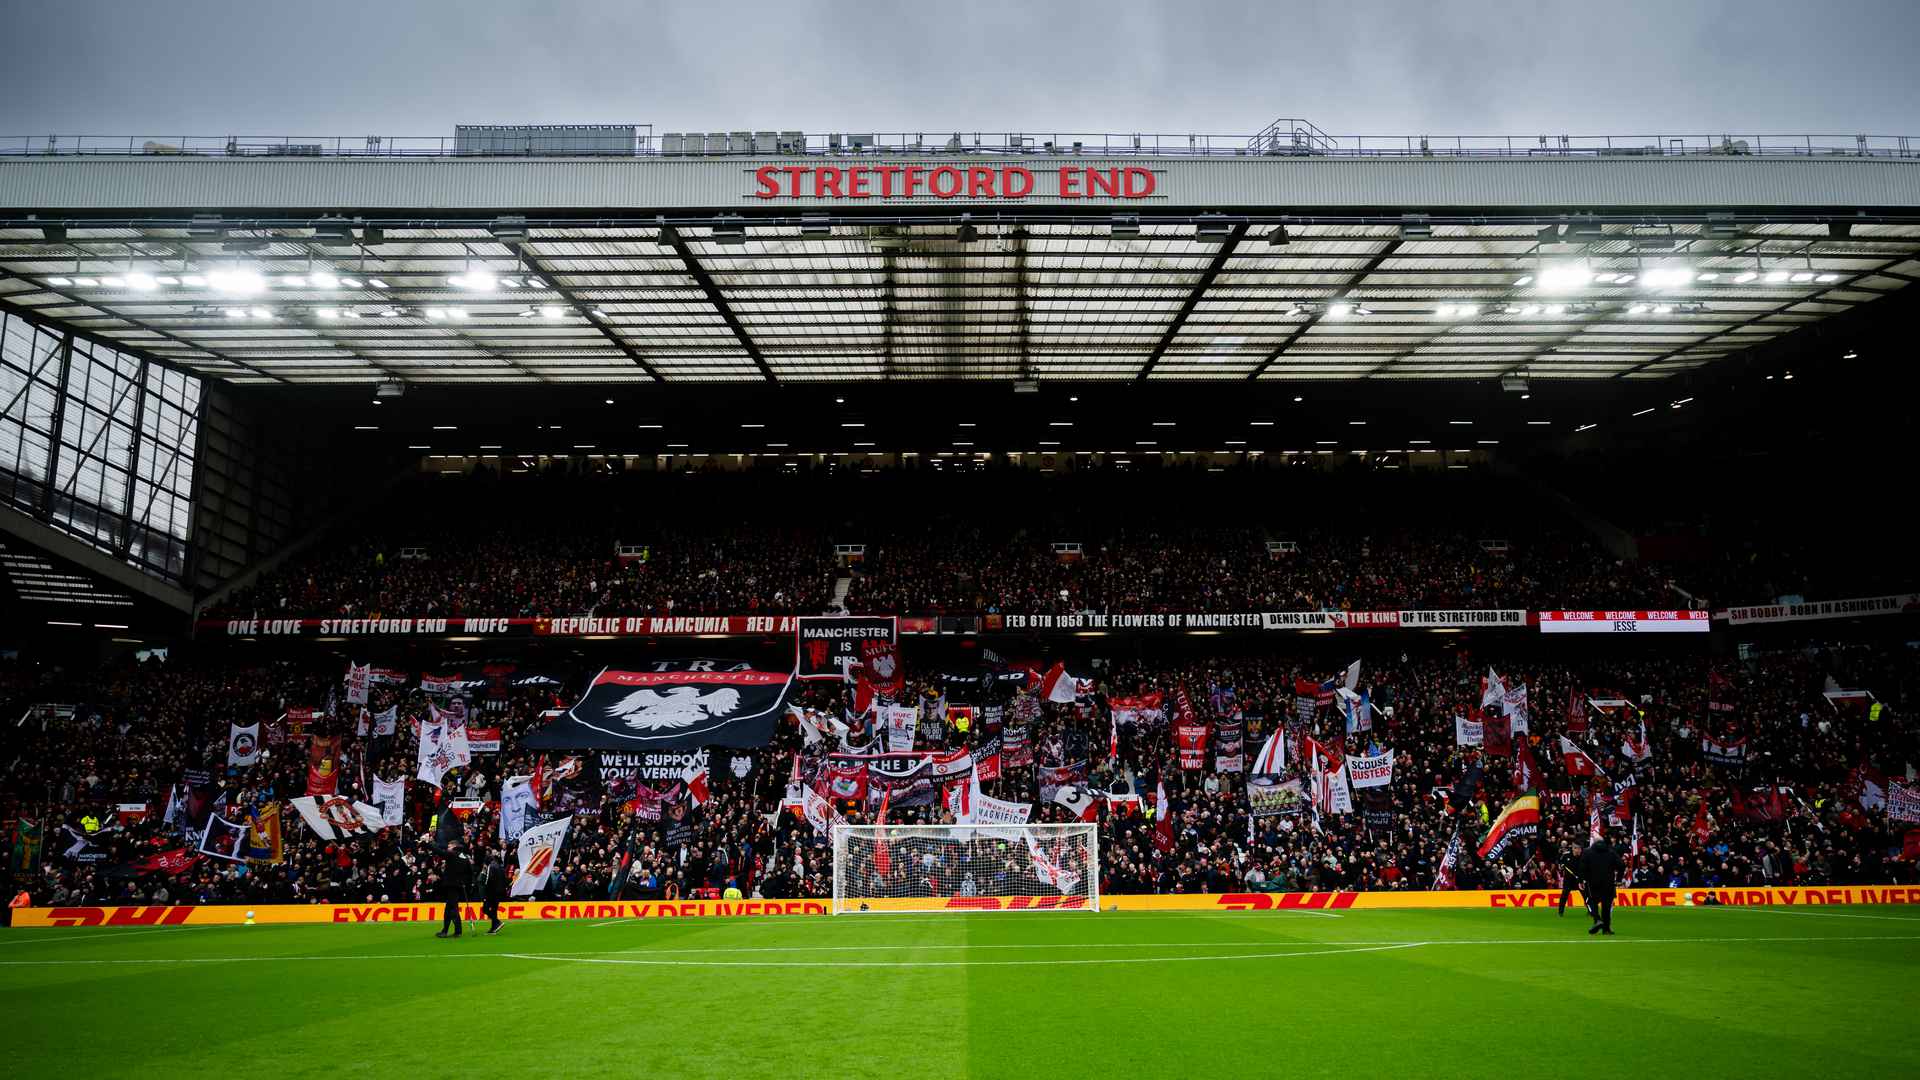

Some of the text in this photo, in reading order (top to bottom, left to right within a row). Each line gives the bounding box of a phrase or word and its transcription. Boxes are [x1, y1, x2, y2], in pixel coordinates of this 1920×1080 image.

[755, 166, 1156, 200] STRETFORD END
[1006, 615, 1026, 628] FEB
[1030, 615, 1052, 628] 6TH
[1088, 614, 1108, 627] THE
[1112, 614, 1165, 627] FLOWERS
[1168, 614, 1182, 627] OF
[1186, 613, 1260, 627] MANCHESTER
[1270, 611, 1520, 625] DENIS LAW THE KING OF THE STRETFORD END
[1563, 611, 1594, 620] WELCOME
[1606, 611, 1636, 620] WELCOME
[1648, 611, 1678, 620] WELCOME
[227, 618, 509, 635] ONE LOVE STRETFORD END MUFC
[626, 617, 644, 633] OF
[747, 616, 774, 632] RED
[1614, 621, 1637, 631] JESSE
[804, 628, 889, 638] MANCHESTER
[840, 642, 852, 652] IS
[617, 674, 771, 682] MANCHESTER
[601, 754, 640, 766] WE'LL
[1352, 757, 1388, 770] SCOUSE
[640, 768, 710, 779] VERME
[1352, 766, 1391, 780] BUSTERS
[1217, 893, 1360, 910] DHL
[1490, 892, 1676, 907] EXCELNCE
[1692, 890, 1798, 905] SMPLY
[47, 907, 195, 926] DHL
[333, 903, 824, 923] EXCELLNCE SIMPLY DELIVERED
